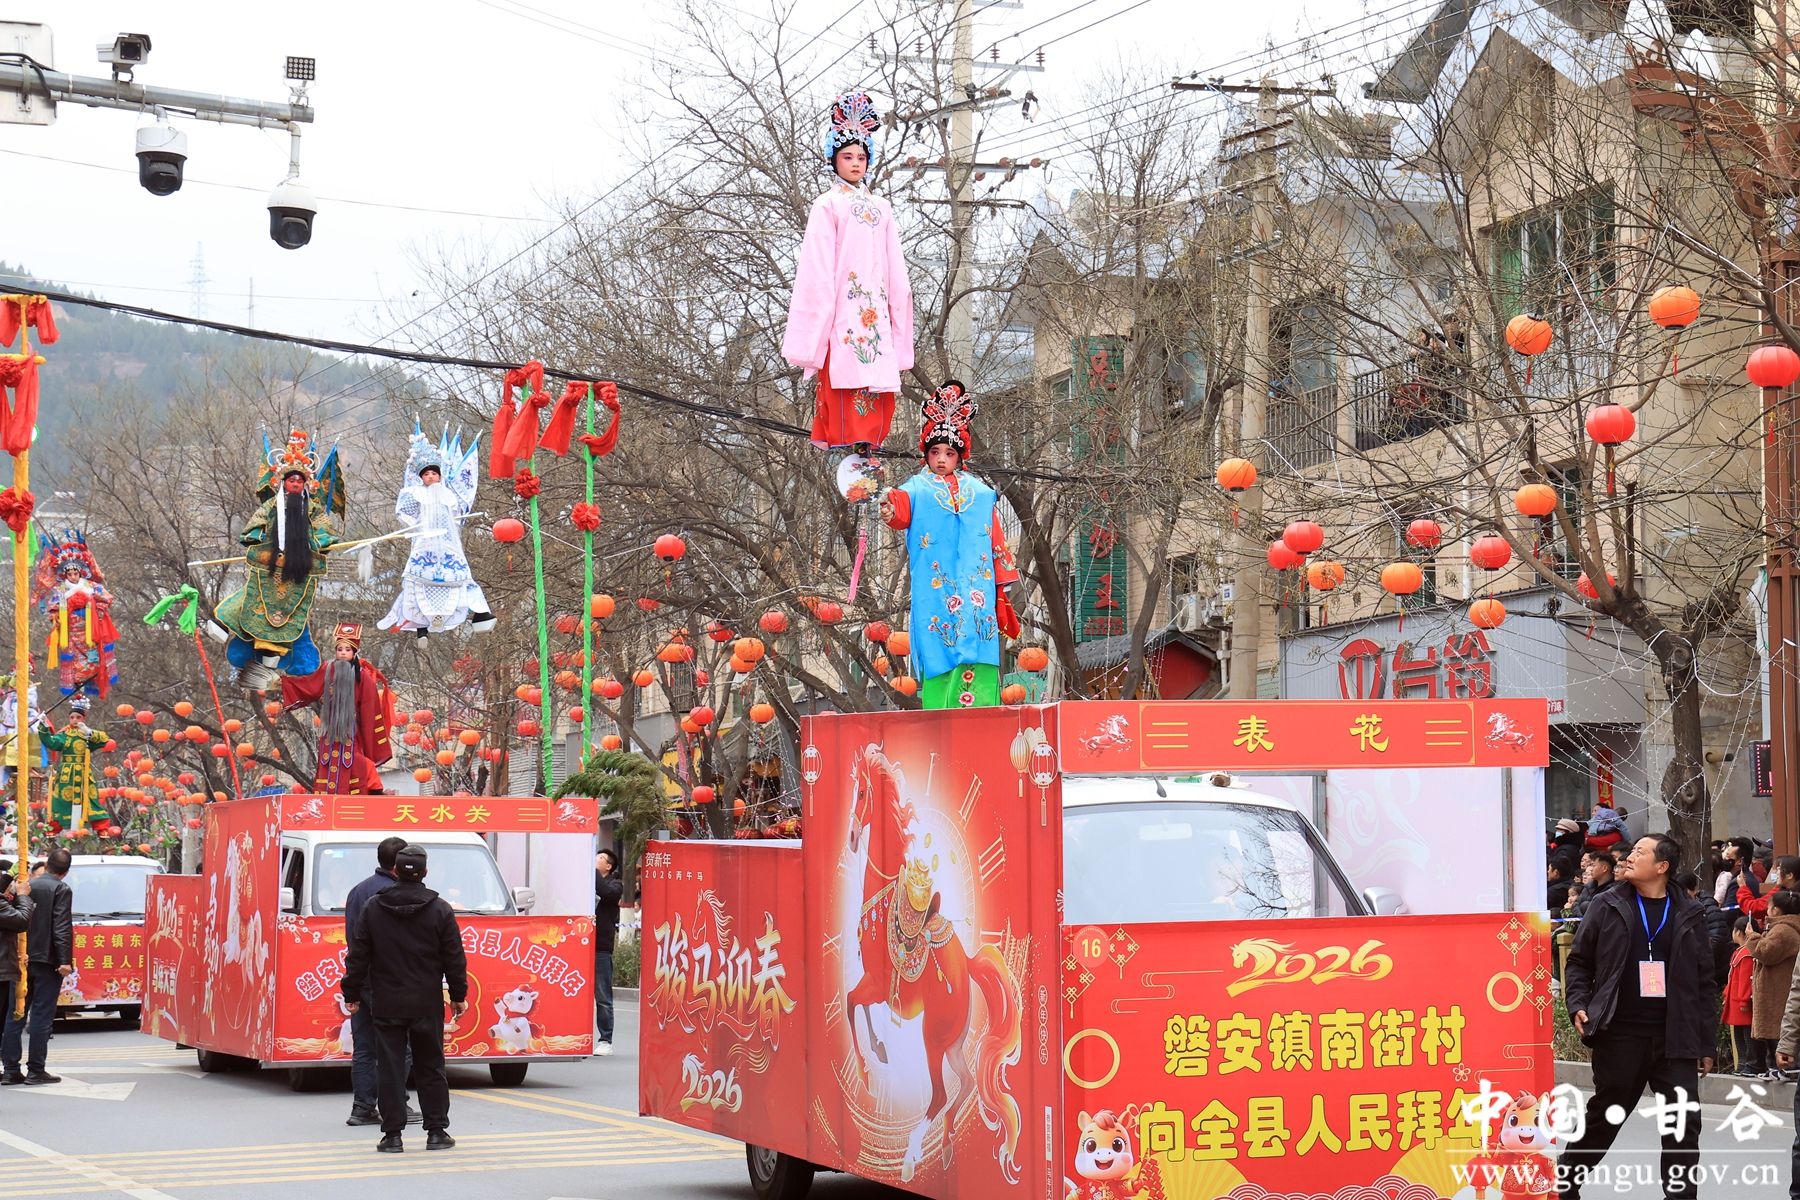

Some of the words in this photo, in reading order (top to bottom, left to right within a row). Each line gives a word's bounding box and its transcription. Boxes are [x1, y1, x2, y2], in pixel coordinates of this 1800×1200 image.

[1233, 713, 1390, 753] 表花
[391, 804, 492, 825] 天水关
[645, 852, 672, 868] 贺新年
[75, 934, 142, 949] 磐安镇东
[576, 922, 588, 933] 17
[1081, 938, 1102, 959] 16
[459, 926, 586, 997] 全县人民拜年
[647, 911, 797, 1052] 骏马迎春
[1225, 937, 1394, 998] 2026
[1163, 1005, 1466, 1077] 磐安镇南街村
[680, 1052, 743, 1113] 2026
[1139, 1087, 1493, 1163] 向全县人民拜年
